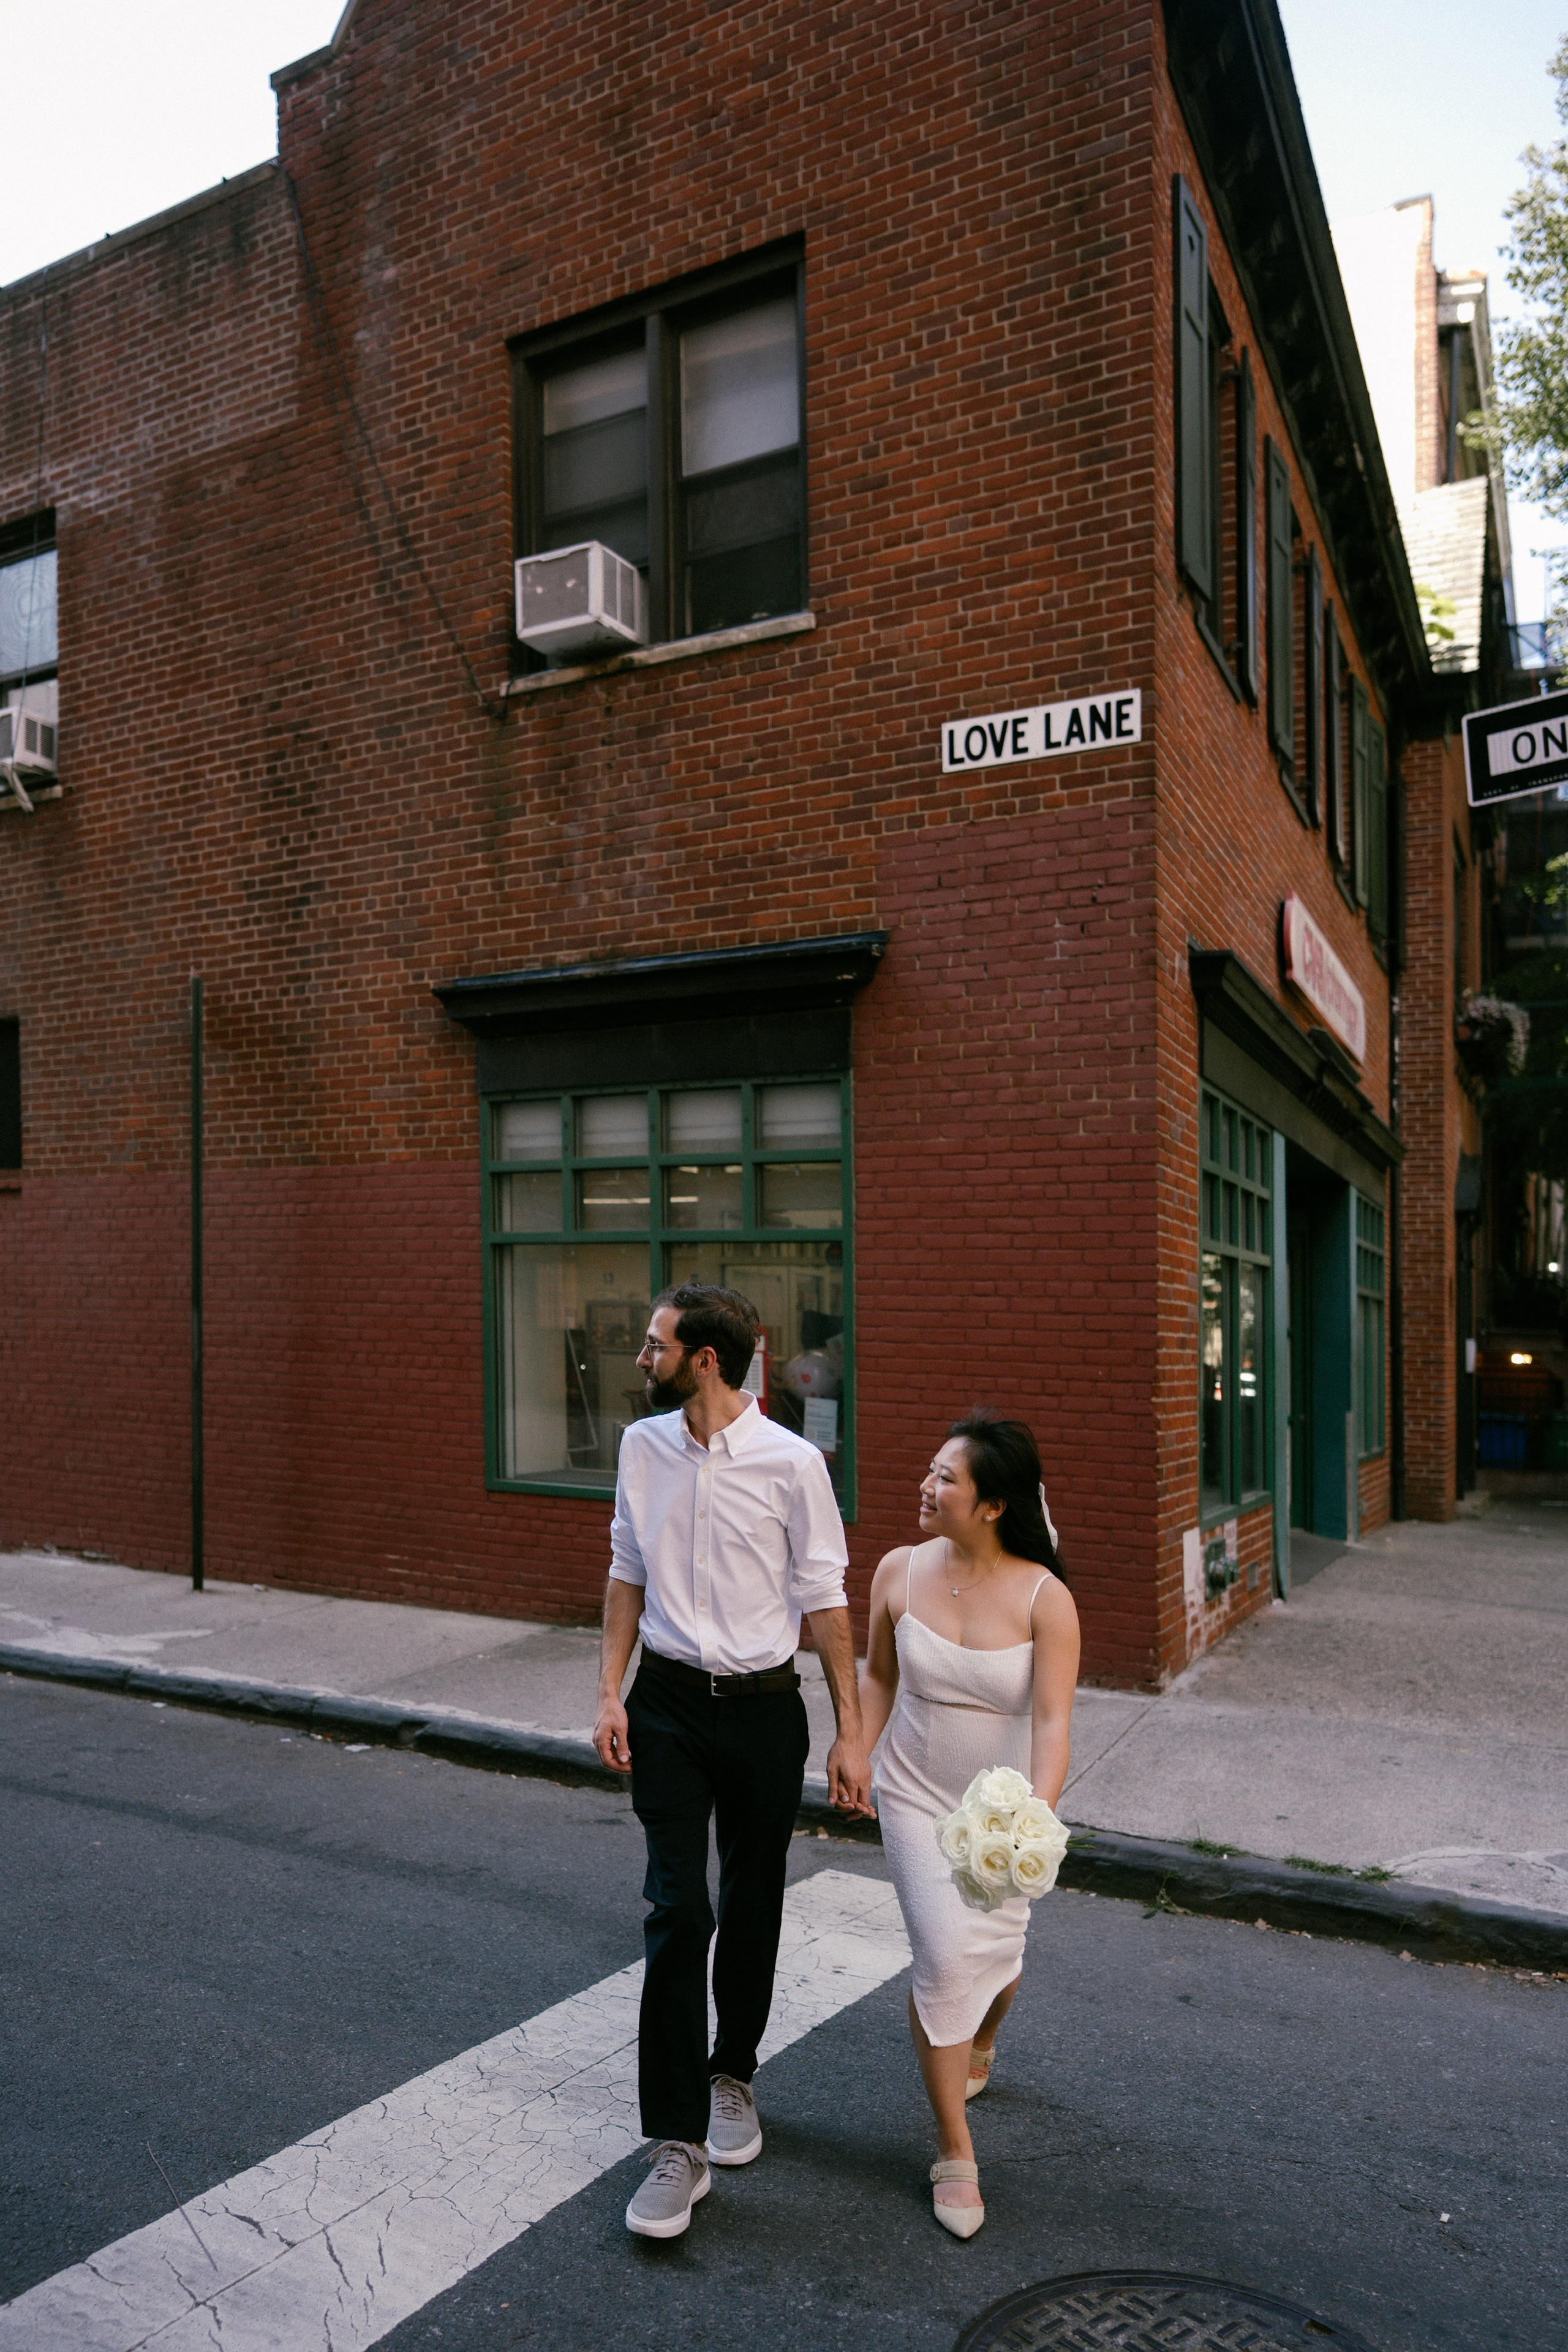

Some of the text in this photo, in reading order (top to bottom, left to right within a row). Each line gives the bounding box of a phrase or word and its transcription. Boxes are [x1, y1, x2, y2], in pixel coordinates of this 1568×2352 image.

[948, 698, 1133, 765] LOVE LANE
[1512, 722, 1568, 764] ON
